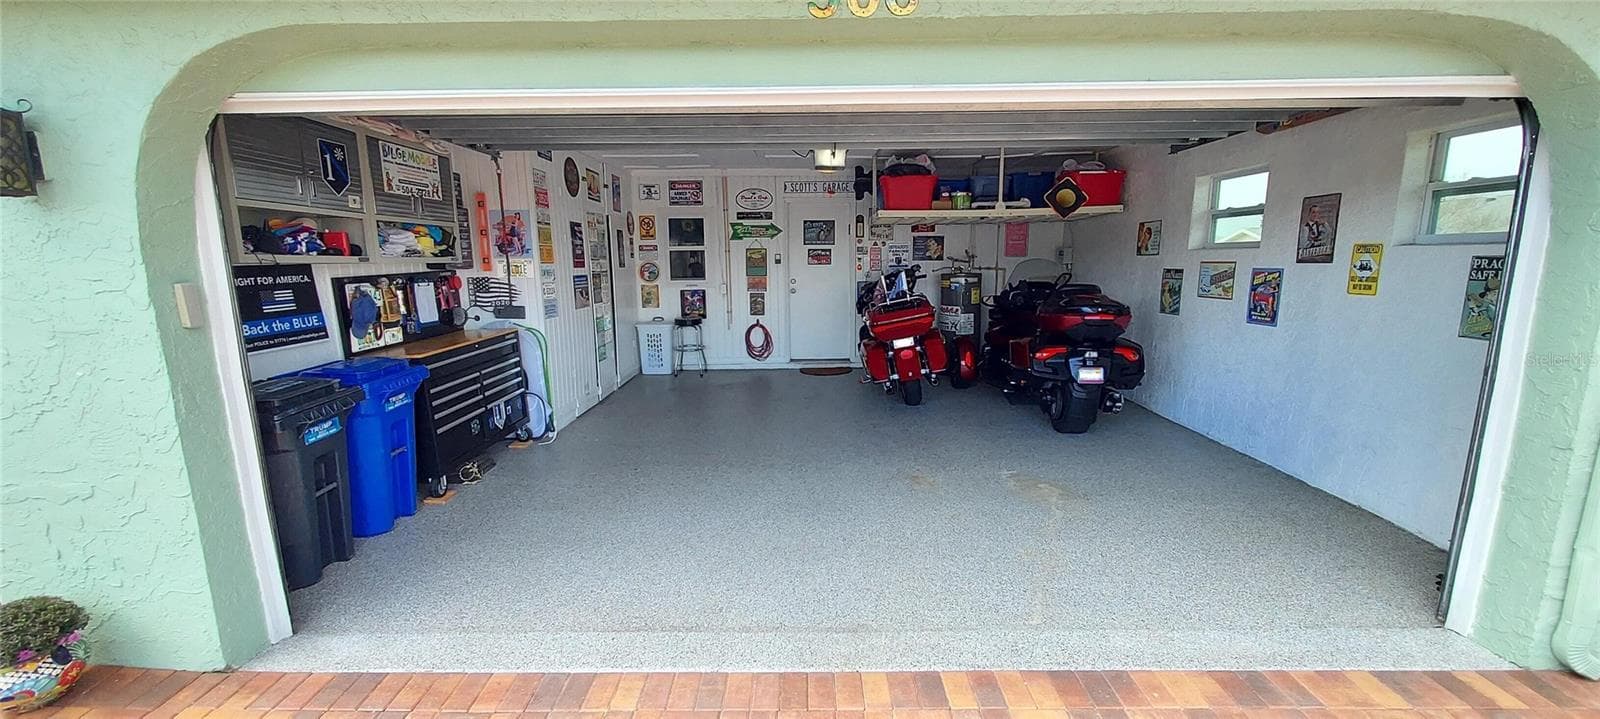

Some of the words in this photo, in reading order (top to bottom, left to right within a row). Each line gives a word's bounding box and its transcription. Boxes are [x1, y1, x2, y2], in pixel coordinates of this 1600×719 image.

[790, 182, 818, 192] SCOTT'S
[822, 182, 850, 192] GARAGE
[234, 277, 256, 287] IGHT
[257, 277, 274, 286] FOR
[242, 322, 269, 335] Back
[272, 320, 290, 331] the
[292, 315, 322, 329] BLUE.
